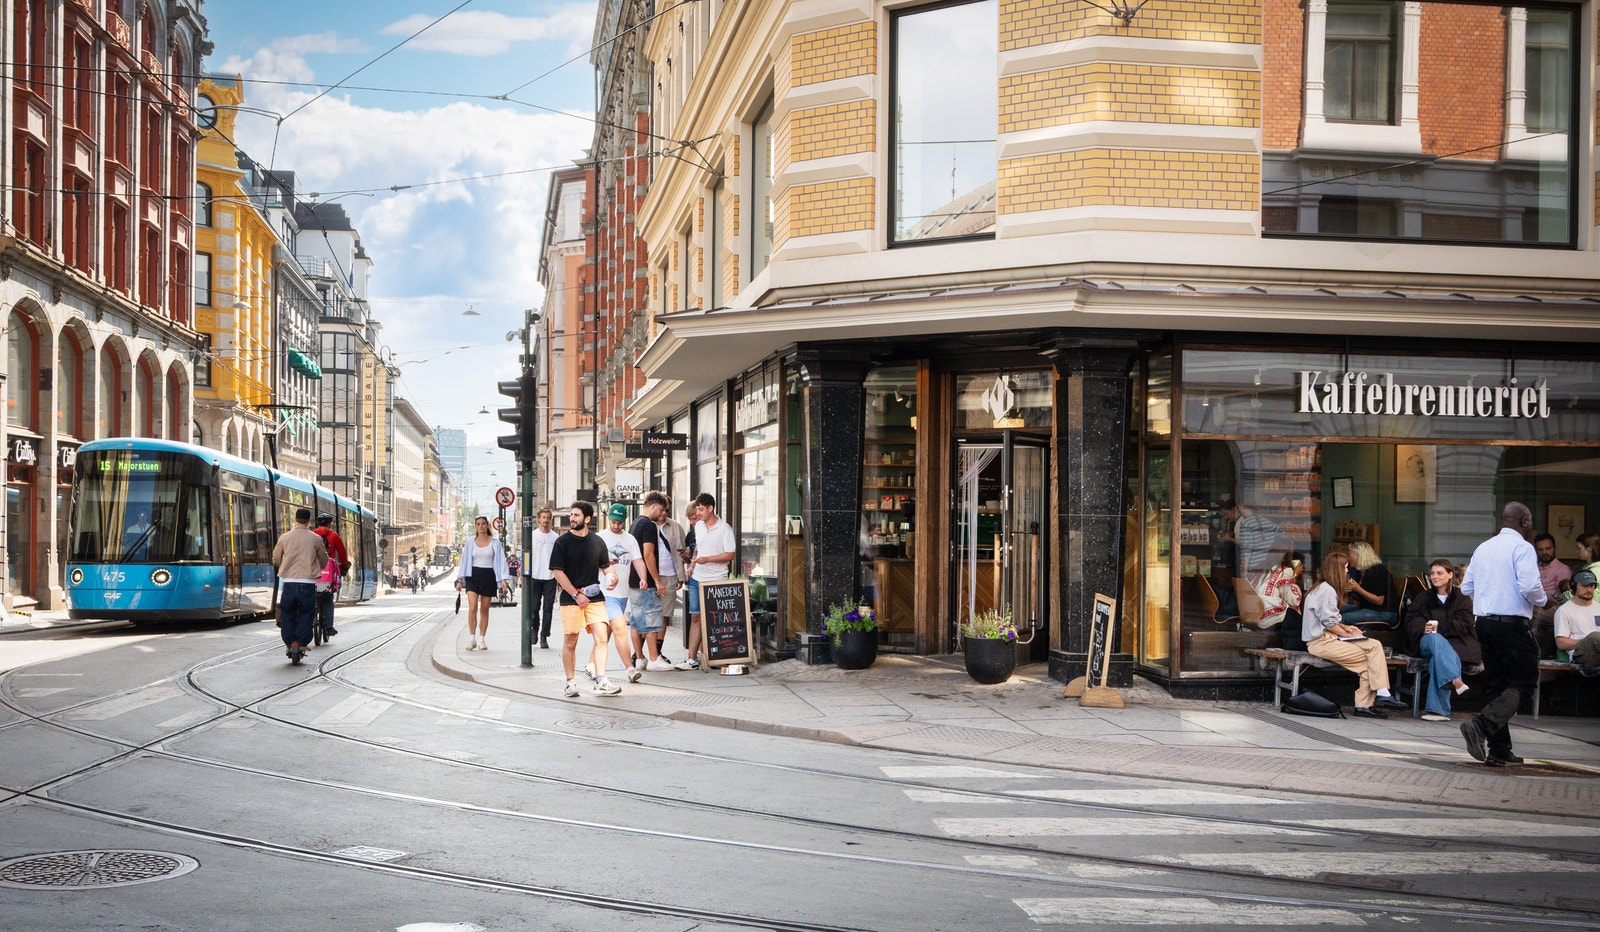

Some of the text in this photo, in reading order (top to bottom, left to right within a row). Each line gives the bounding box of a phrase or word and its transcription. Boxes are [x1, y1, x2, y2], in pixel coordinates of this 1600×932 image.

[365, 362, 373, 400] SALE
[1298, 370, 1550, 419] Kaffebrenneriet
[647, 437, 681, 445] Holzweiler
[100, 460, 159, 472] 15 Majorstuen
[616, 484, 640, 492] GANNI
[103, 571, 126, 583] 475
[707, 586, 743, 599] MÅNEDENS
[716, 599, 736, 610] KAFFE
[709, 610, 740, 625] FRANSK
